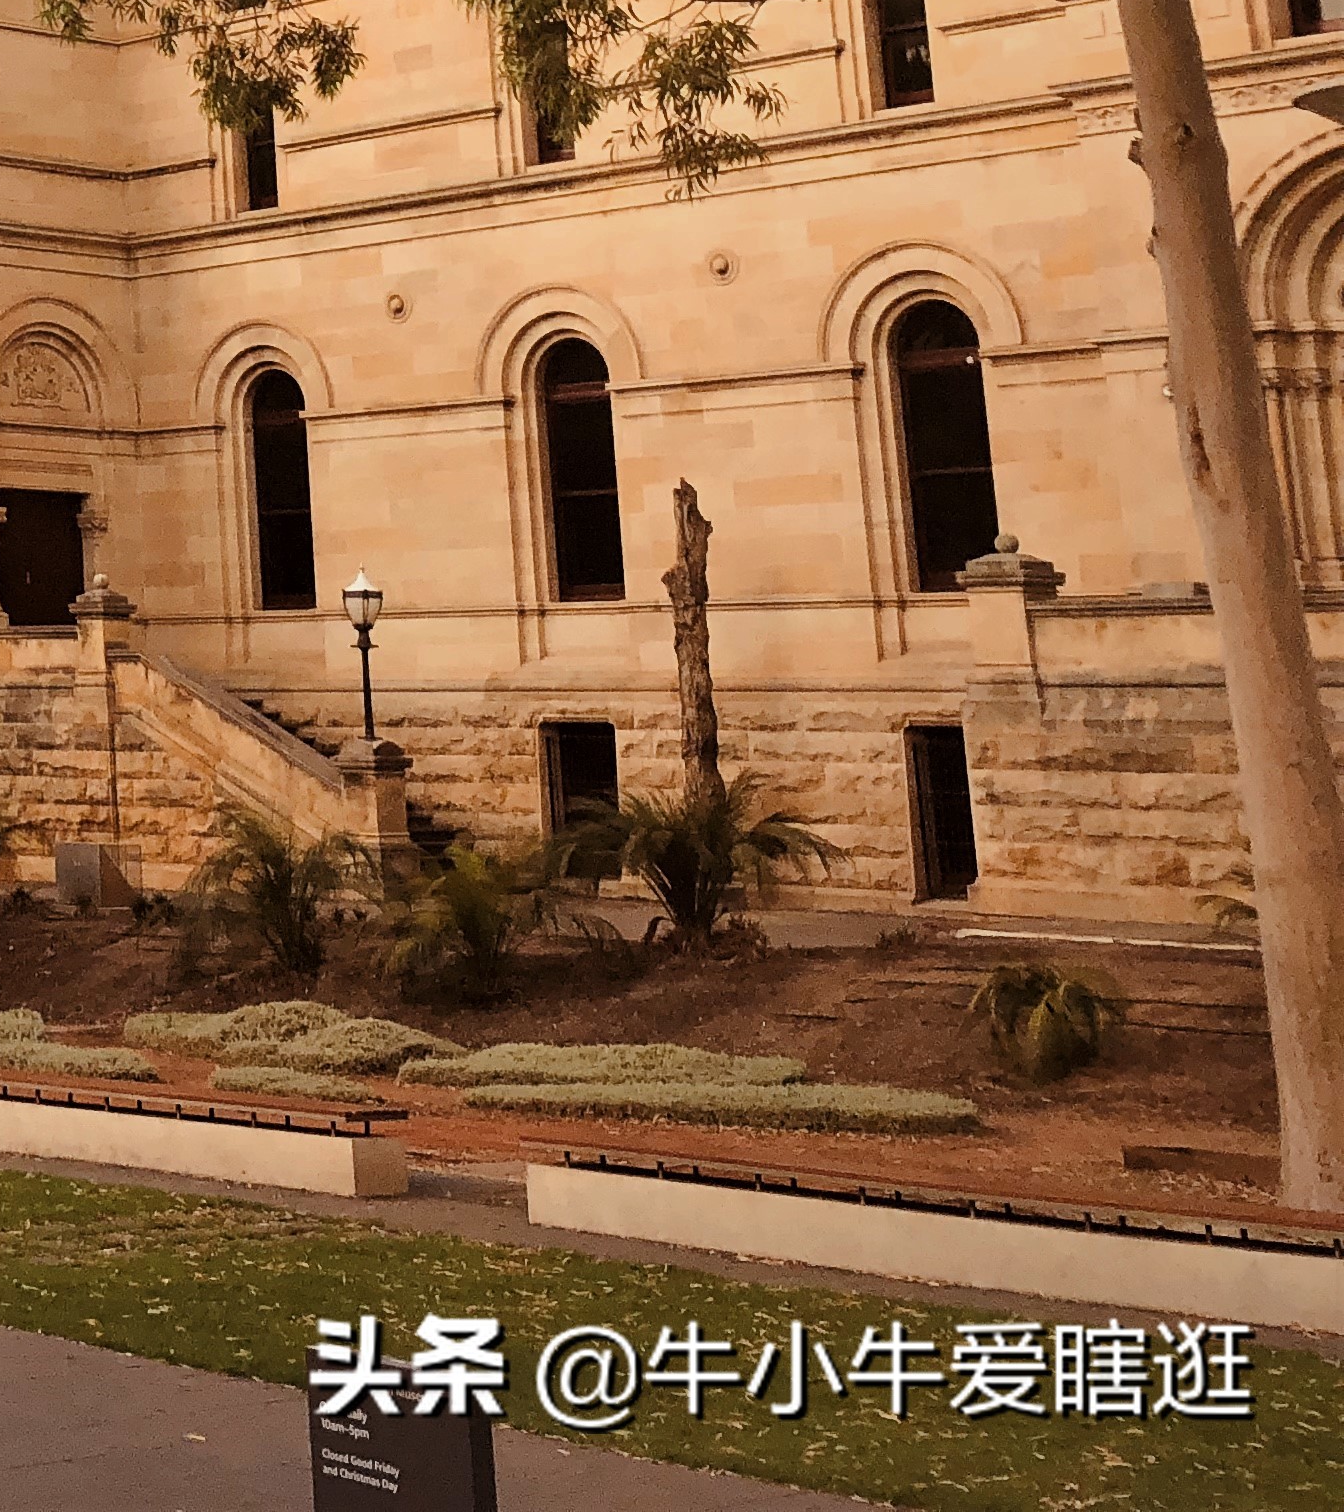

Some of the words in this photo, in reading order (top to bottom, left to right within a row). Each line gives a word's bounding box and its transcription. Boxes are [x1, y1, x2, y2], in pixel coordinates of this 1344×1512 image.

[321, 1448, 350, 1464] Closed
[350, 1455, 373, 1470] Good
[374, 1460, 400, 1479] Friday
[322, 1465, 339, 1476] and
[339, 1468, 381, 1488] Christmas
[381, 1478, 399, 1494] Day
